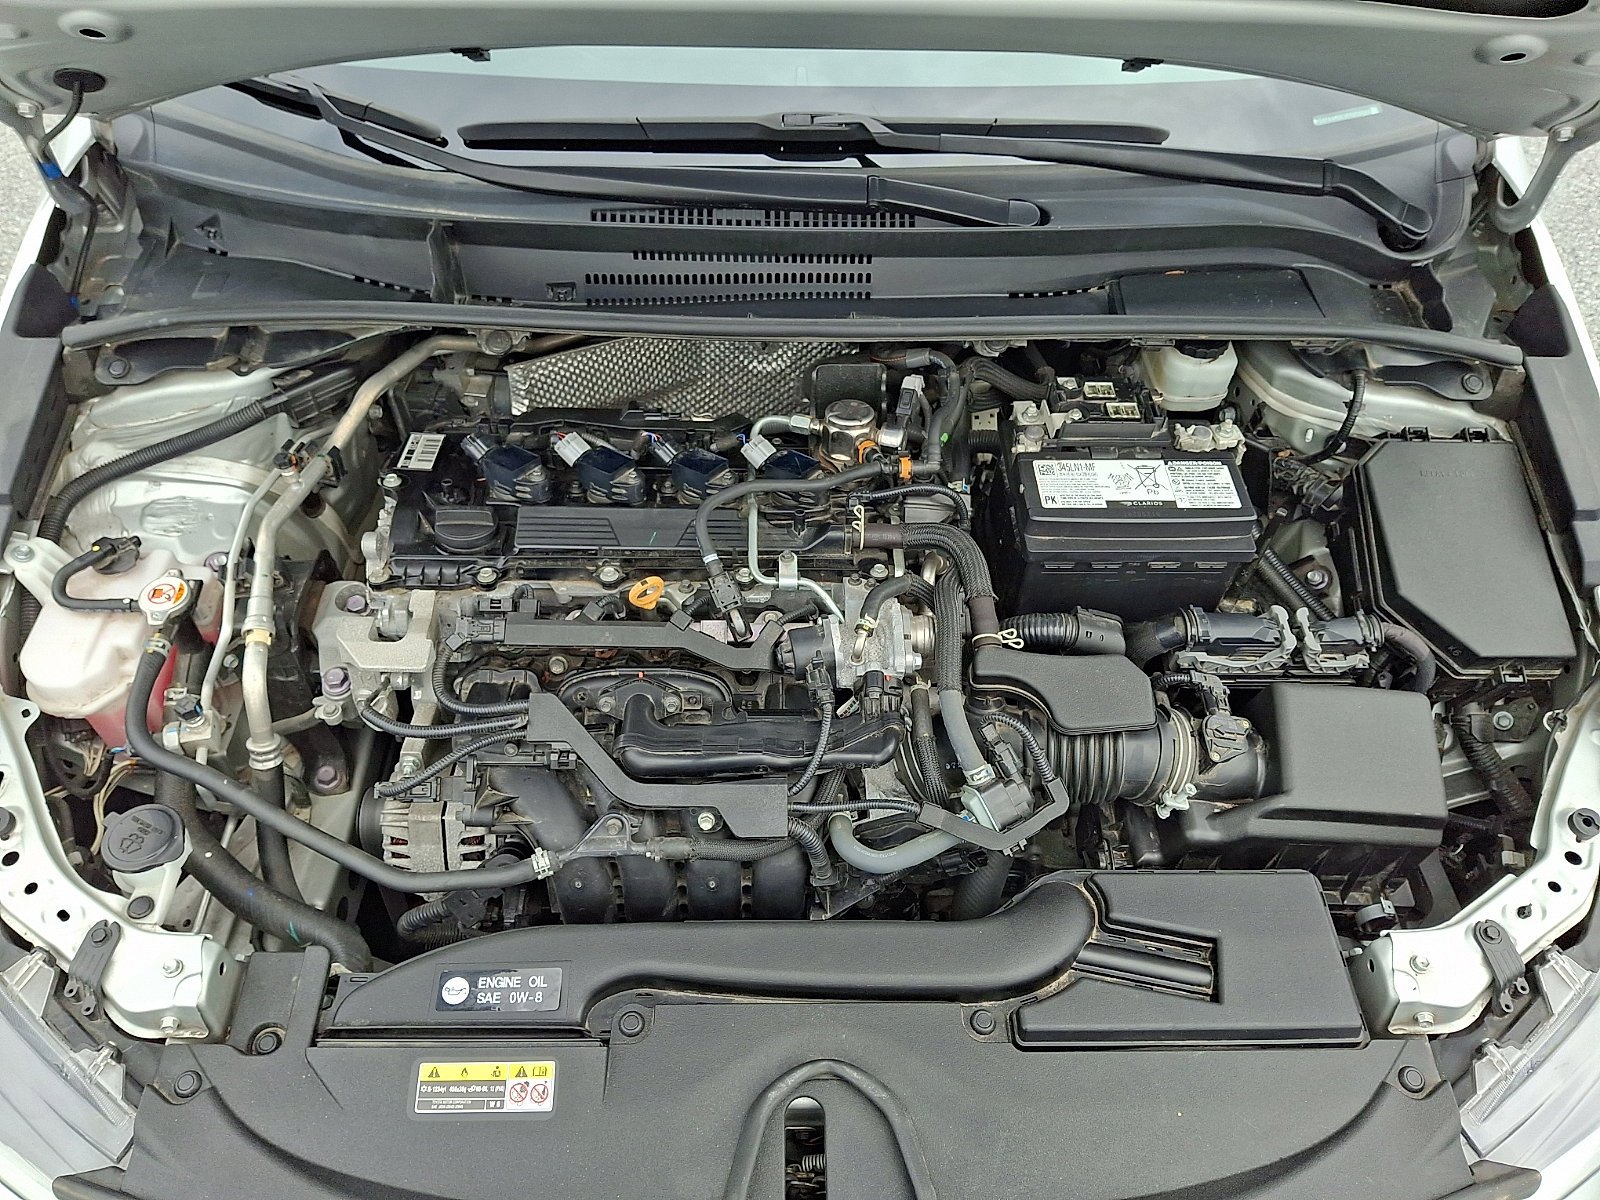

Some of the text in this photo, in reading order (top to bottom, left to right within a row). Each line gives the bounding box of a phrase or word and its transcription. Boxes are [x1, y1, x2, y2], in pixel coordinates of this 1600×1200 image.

[1044, 495, 1057, 505] PK
[478, 975, 548, 989] ENGINE OIL
[476, 991, 543, 1004] SAE 0W-8
